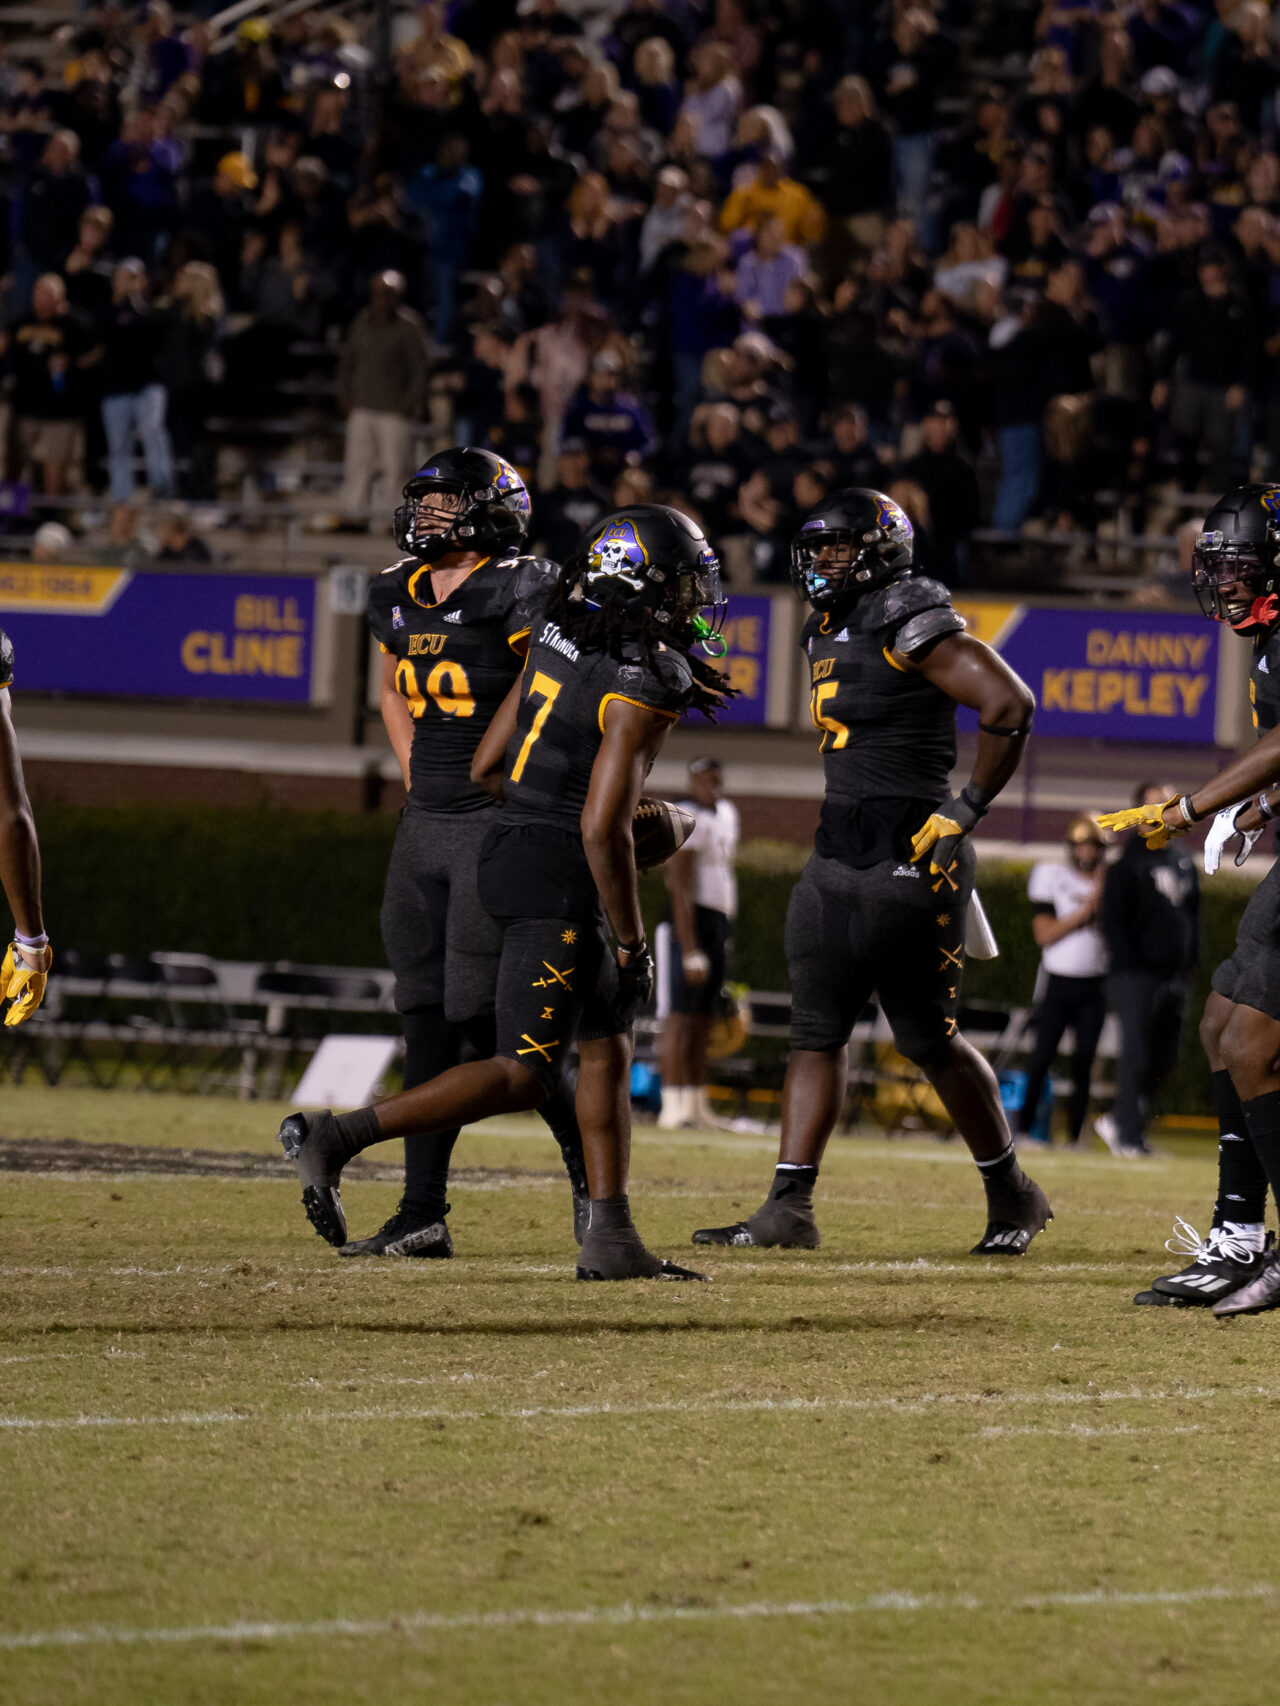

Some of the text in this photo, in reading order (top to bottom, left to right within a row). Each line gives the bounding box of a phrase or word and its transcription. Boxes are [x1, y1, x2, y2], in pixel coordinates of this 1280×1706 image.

[606, 527, 629, 537] ECU
[234, 594, 304, 632] BILL
[181, 630, 304, 679] CLINE
[407, 633, 448, 656] ECU
[1086, 629, 1211, 669] DANNY
[1042, 668, 1208, 717] KEPLEY
[510, 670, 563, 783] 7
[892, 868, 920, 879] adidas
